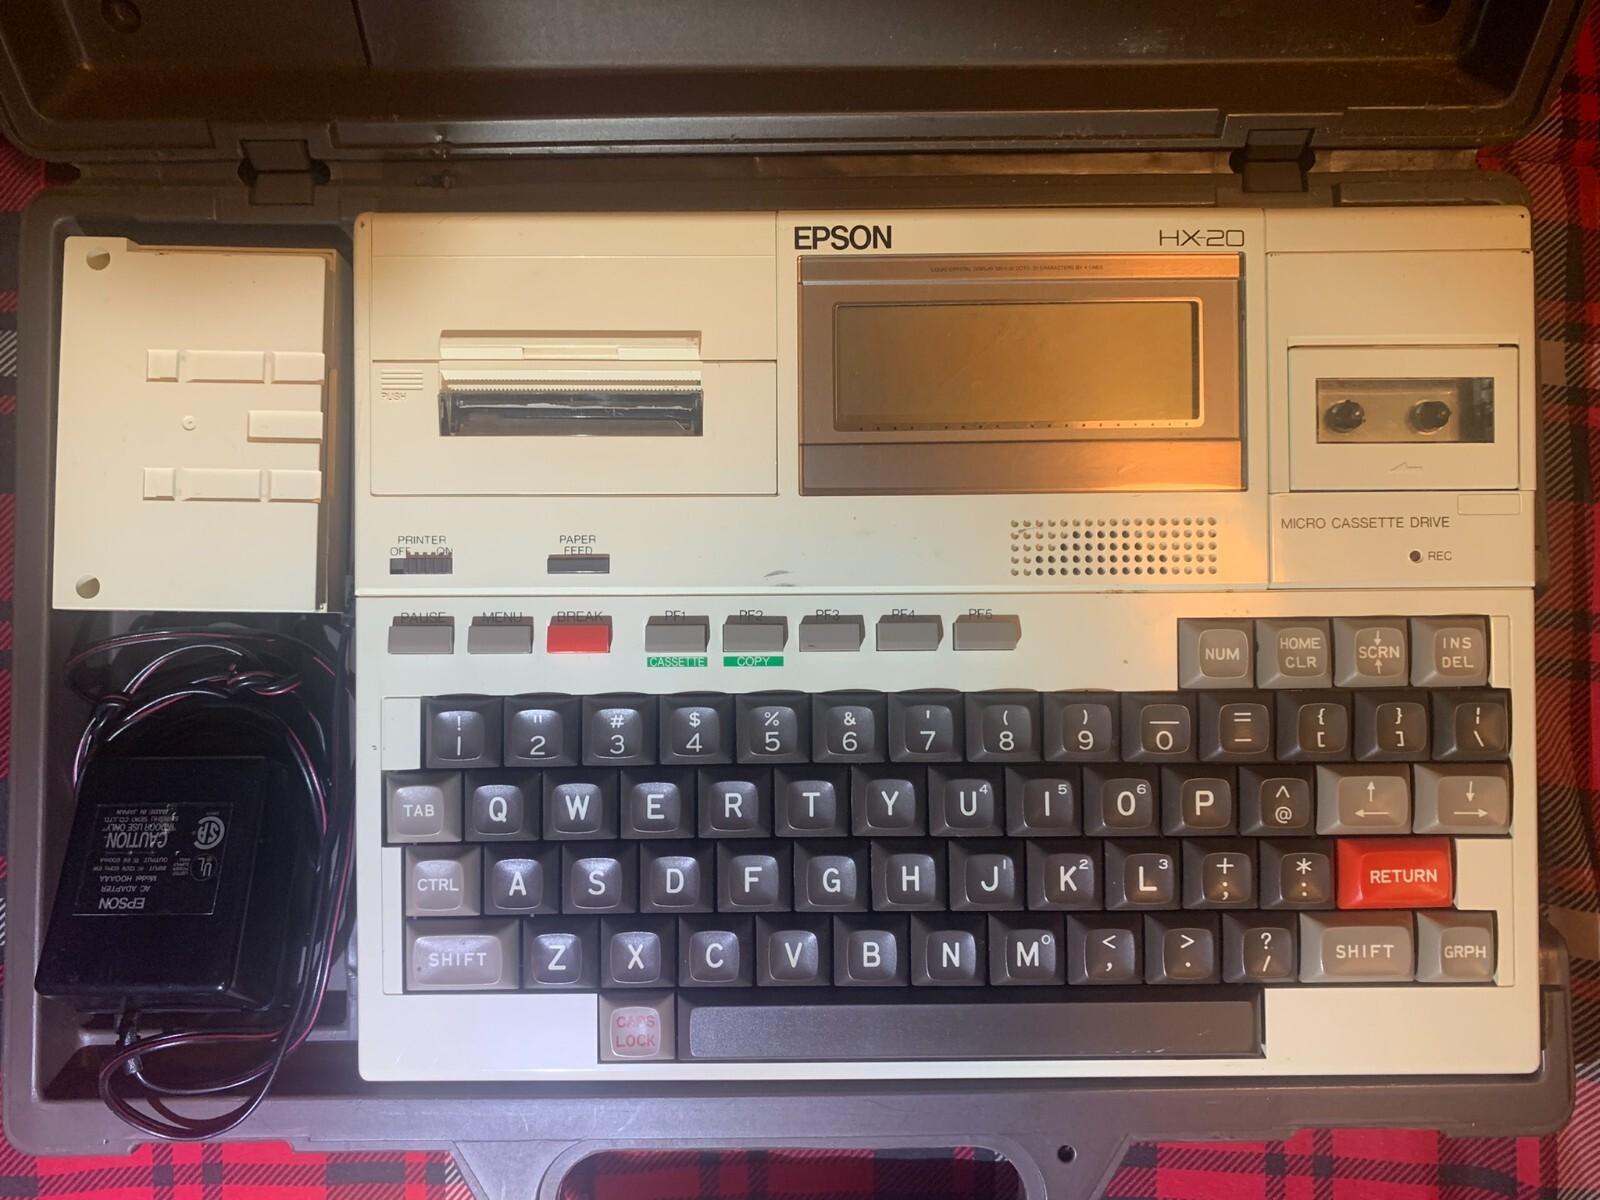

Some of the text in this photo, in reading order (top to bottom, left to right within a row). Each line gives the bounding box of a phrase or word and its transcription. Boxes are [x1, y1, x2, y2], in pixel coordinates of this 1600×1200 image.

[794, 225, 892, 250] EPSON
[1159, 229, 1244, 247] HX-20
[381, 392, 406, 400] PUSH
[1281, 517, 1449, 529] MICRO CASSETTE DRIVE
[398, 536, 447, 544] PRINTER
[559, 535, 596, 544] PAPER
[436, 547, 453, 556] ON
[564, 546, 592, 555] FEED
[1428, 551, 1452, 561] REC
[401, 612, 446, 623] PAUSE
[483, 612, 522, 623] MENU
[557, 611, 603, 622] BREAK
[665, 611, 686, 621] PF1
[740, 610, 763, 621] PF2
[816, 610, 840, 621] PF3
[892, 609, 915, 620] PF4
[969, 609, 993, 620] PF5
[1280, 638, 1320, 650] HOME
[1443, 637, 1471, 649] INS
[1205, 647, 1239, 661] NUM
[1359, 646, 1400, 659] SCRN
[650, 657, 705, 667] CASSETTE
[737, 656, 769, 666] COPY
[1285, 656, 1317, 668] CLR
[1442, 656, 1474, 668] DEL
[610, 715, 624, 728] #
[689, 711, 701, 728] $
[764, 711, 779, 727] %
[843, 712, 856, 726] &
[1003, 710, 1008, 725] (
[1083, 709, 1088, 724] )
[1317, 708, 1325, 725] {
[1396, 707, 1403, 724] }
[530, 736, 545, 755] 2
[610, 735, 625, 754] 3
[686, 733, 702, 752] 4
[765, 732, 780, 751] 5
[842, 731, 858, 751] 6
[920, 731, 936, 750] 7
[999, 731, 1014, 750] 8
[1078, 730, 1094, 750] 9
[1318, 732, 1325, 747] [
[1396, 731, 1404, 746] ]
[1473, 730, 1484, 747] \
[1137, 784, 1147, 794] 6
[565, 795, 590, 821] W
[647, 794, 664, 819] E
[725, 792, 743, 818] R
[802, 792, 820, 817] T
[881, 791, 899, 816] Y
[959, 784, 989, 816] U 4
[1045, 784, 1067, 816] I 5
[1195, 790, 1214, 815] P
[403, 805, 435, 817] TAB
[488, 796, 507, 823] Q
[1275, 806, 1292, 823] @
[105, 832, 168, 848] CAUTION
[588, 871, 606, 895] S
[666, 869, 684, 894] D
[744, 867, 762, 893] F
[822, 868, 841, 893] G
[901, 866, 920, 891] H
[980, 866, 999, 892] J
[1059, 859, 1089, 891] K 2
[1139, 859, 1168, 891] L 3
[1370, 869, 1437, 884] RETURN
[417, 879, 459, 892] CTRL
[509, 872, 527, 896] A
[98, 897, 145, 909] EPSON
[1261, 932, 1272, 950] ?
[548, 945, 566, 971] Z
[628, 944, 644, 970] X
[705, 943, 724, 969] C
[784, 942, 803, 968] V
[863, 942, 881, 967] B
[942, 942, 960, 968] N
[1016, 941, 1039, 967] M
[1335, 944, 1394, 959] SHIFT
[1444, 945, 1486, 958] GRPH
[429, 953, 487, 967] SHIFT
[616, 1015, 655, 1028] CAPS
[616, 1034, 655, 1048] LOCK
